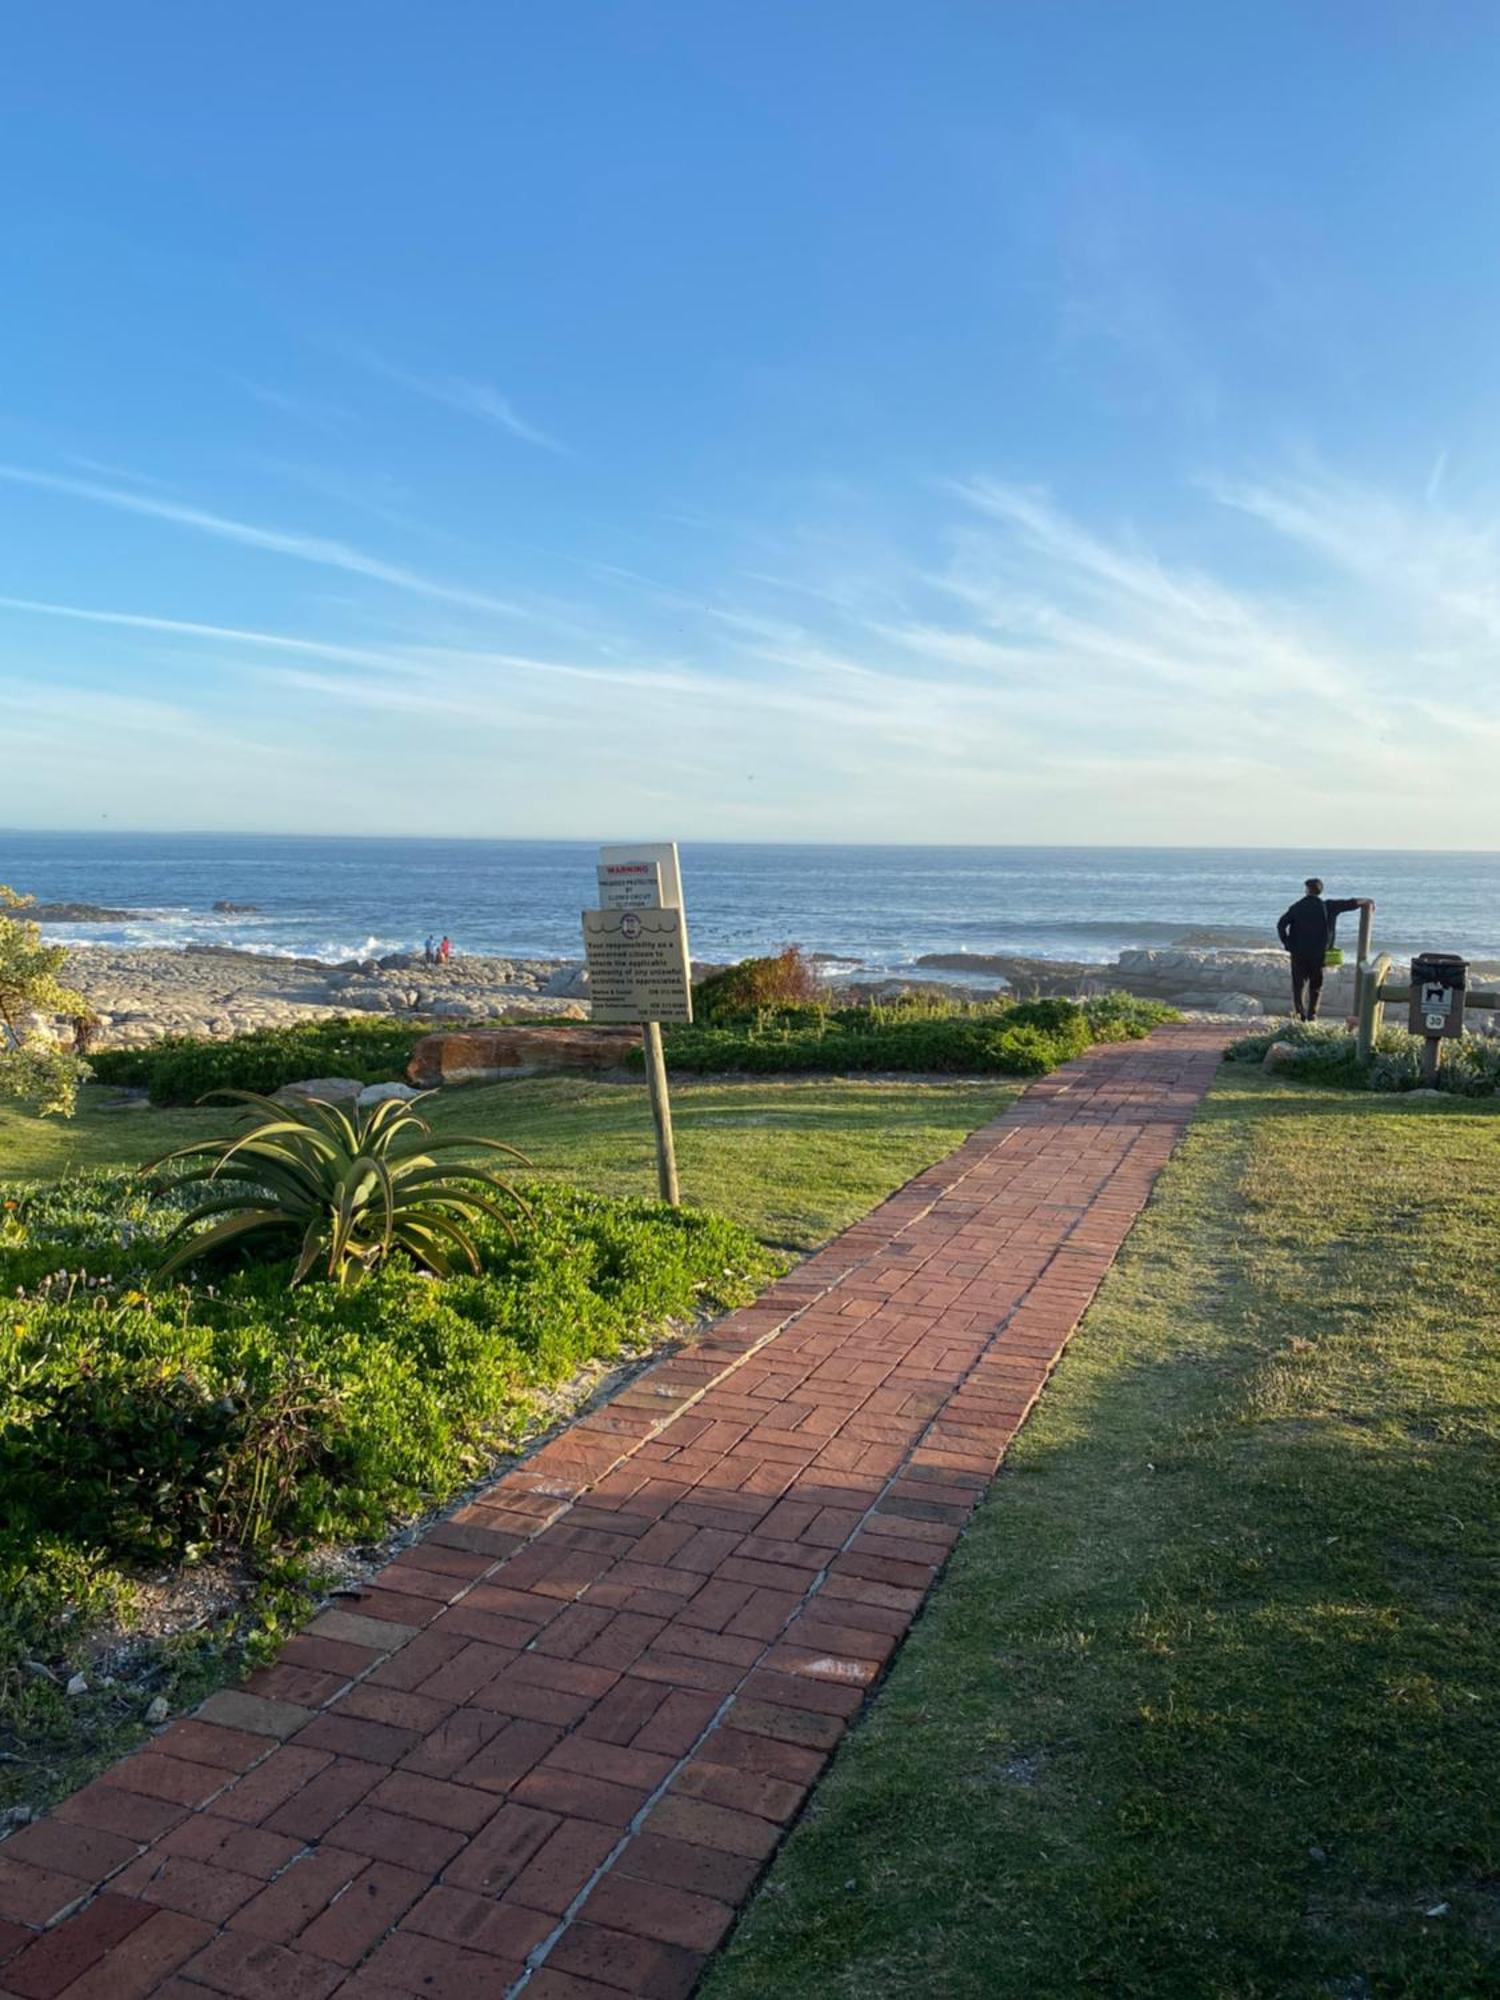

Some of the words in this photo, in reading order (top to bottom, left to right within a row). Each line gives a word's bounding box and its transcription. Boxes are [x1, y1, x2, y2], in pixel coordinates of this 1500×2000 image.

[607, 865, 649, 873] WARNING
[605, 941, 655, 950] responsibility
[628, 959, 667, 968] applicable
[591, 969, 623, 977] authority
[634, 969, 648, 977] any
[649, 967, 682, 975] unlawful
[591, 977, 625, 985] activities
[635, 977, 683, 986] appreciated.
